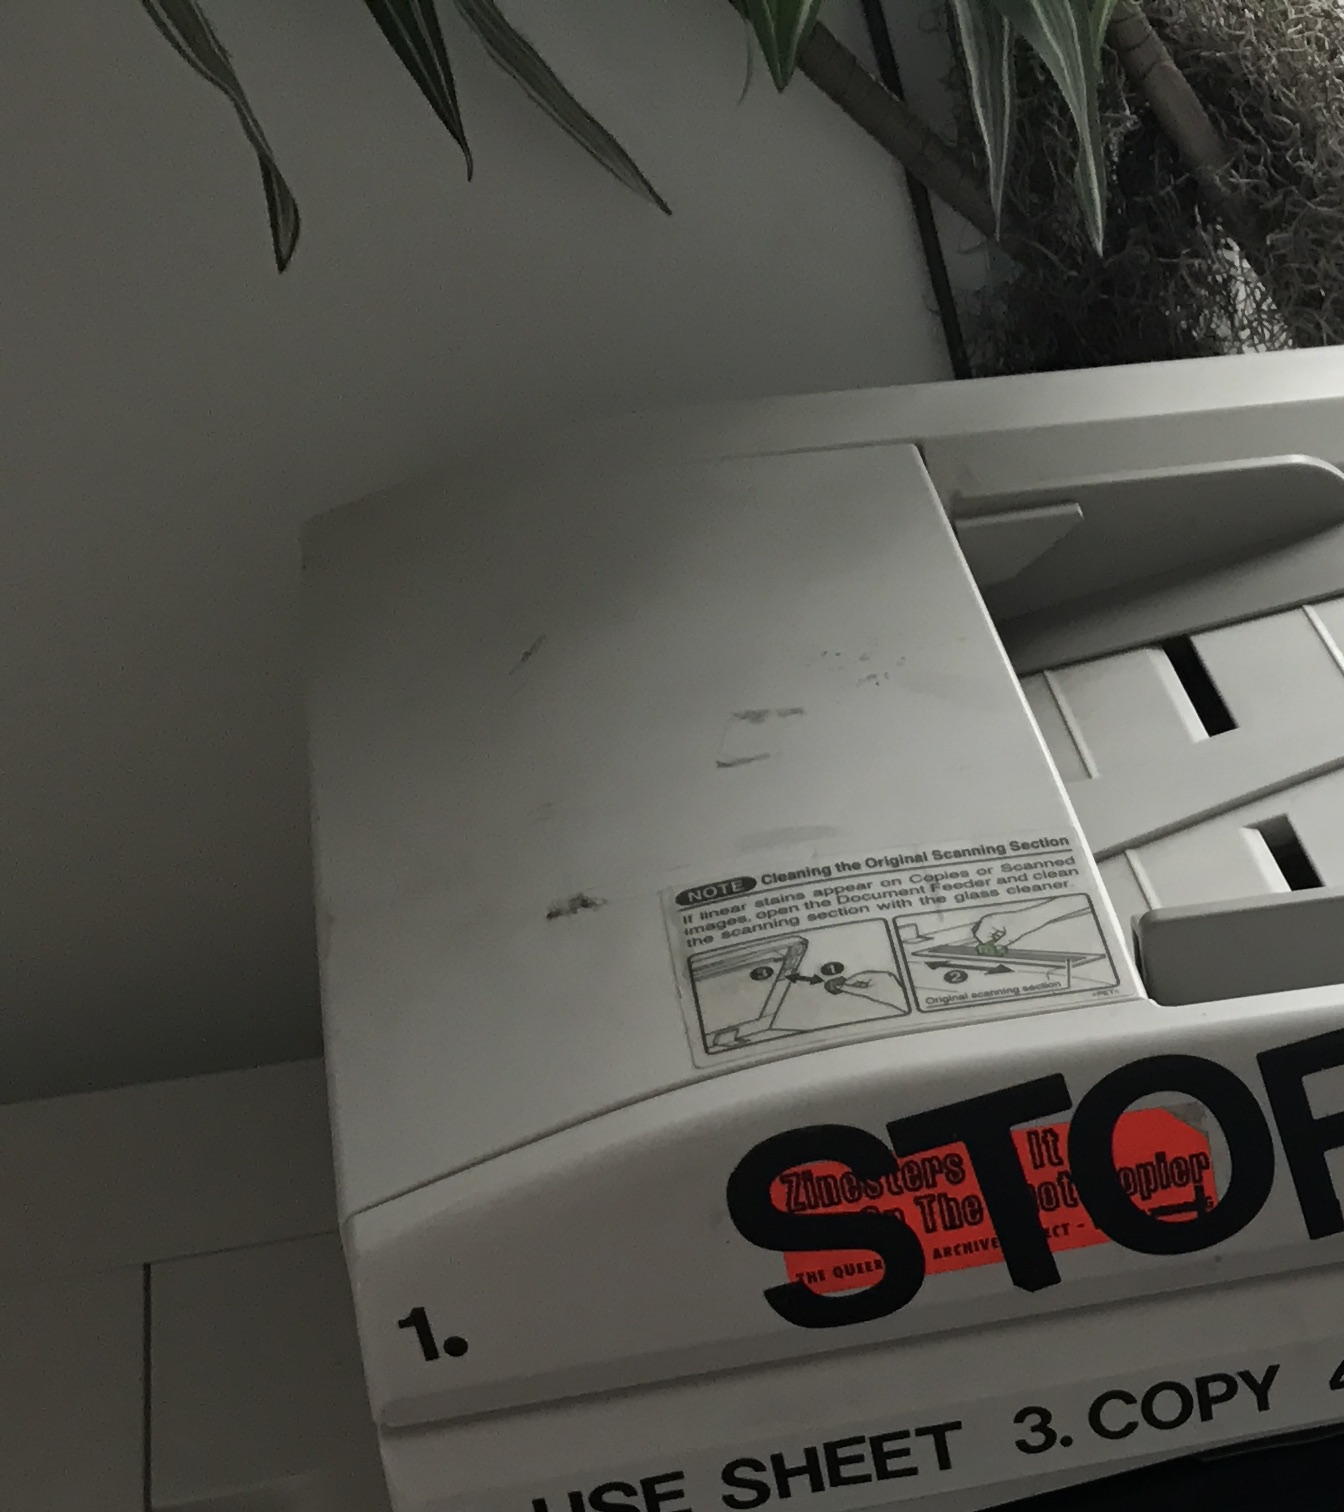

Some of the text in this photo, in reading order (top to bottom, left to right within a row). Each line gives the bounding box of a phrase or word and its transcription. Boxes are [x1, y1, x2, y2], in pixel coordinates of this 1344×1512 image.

[686, 835, 1070, 903] NOTE Cleaning the Original Scanning Section
[699, 903, 747, 921] linear
[754, 891, 806, 908] stains
[812, 880, 874, 898] appear
[880, 877, 902, 888] on
[908, 868, 970, 884] Copies
[976, 866, 994, 877] or
[1000, 855, 1076, 873] Scanned
[755, 903, 799, 922] open
[804, 897, 832, 911] the
[836, 884, 927, 906] Document
[930, 877, 991, 893] Feeder
[996, 872, 1028, 886] and
[1032, 867, 1080, 882] clean
[686, 934, 715, 948] the
[720, 915, 801, 940] scanning
[806, 904, 870, 923] section
[876, 898, 913, 914] with
[918, 891, 947, 906] the
[953, 886, 1001, 903] glass
[924, 979, 1062, 1007] Original scanning section
[915, 1192, 985, 1235] The
[1116, 1151, 1210, 1199] opier
[832, 1259, 886, 1280] QUEER
[932, 1235, 1000, 1261] ARCHIVE
[398, 1306, 470, 1362] 1.
[720, 1420, 962, 1510] SHEET
[1012, 1407, 1074, 1456] 3.
[1085, 1364, 1281, 1441] COPY
